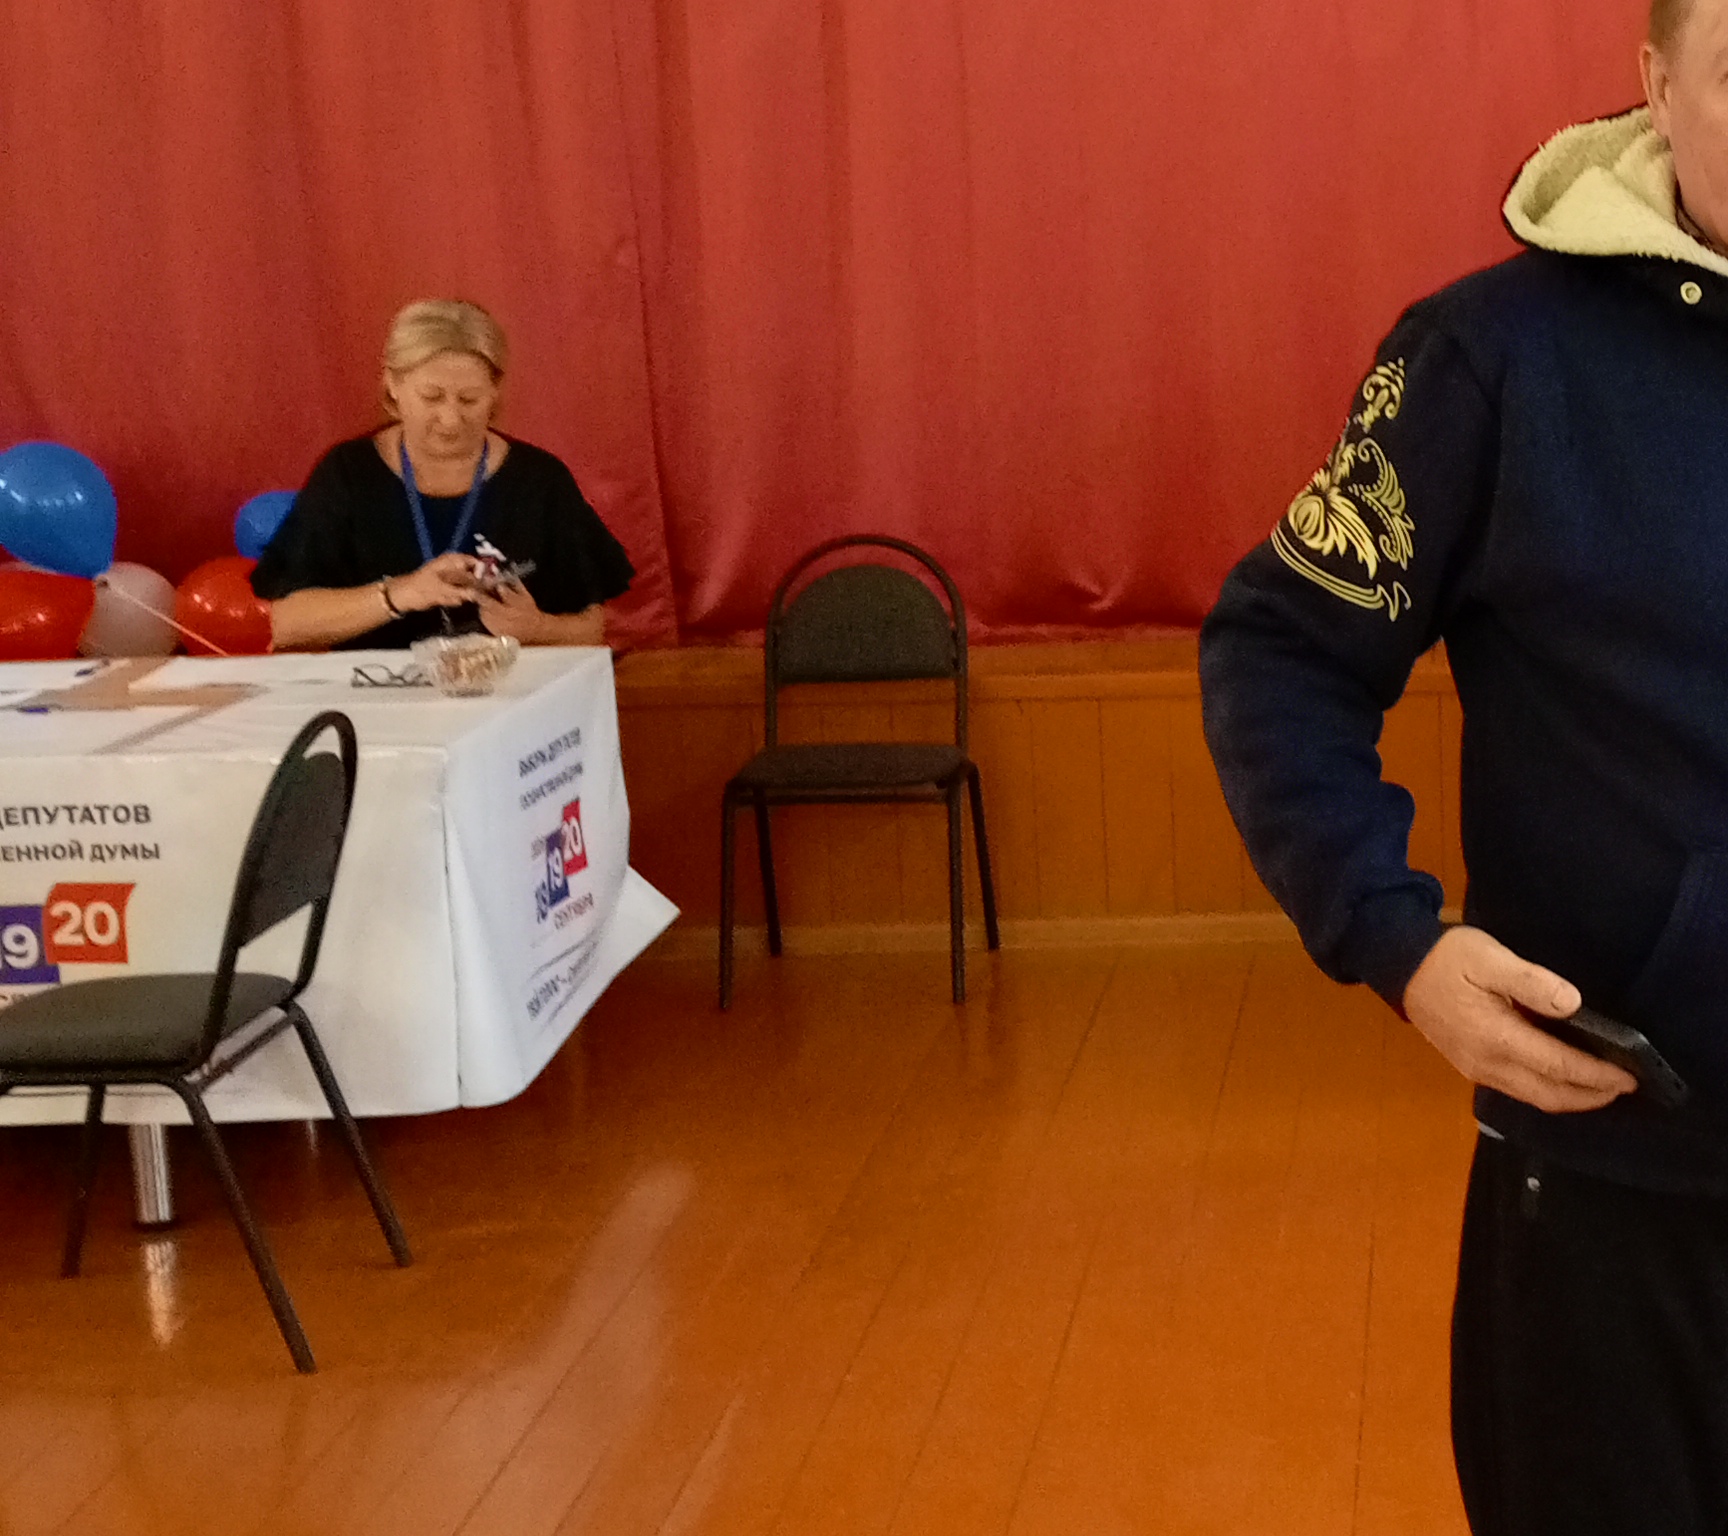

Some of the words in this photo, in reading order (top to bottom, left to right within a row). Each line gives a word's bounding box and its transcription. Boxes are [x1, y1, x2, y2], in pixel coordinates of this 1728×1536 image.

[0, 804, 151, 830] ЕПУТАТОВ
[0, 839, 83, 862] ЕННОЙ
[90, 842, 160, 863] ДУМЫ
[0, 923, 40, 969] 9
[50, 900, 120, 946] 20
